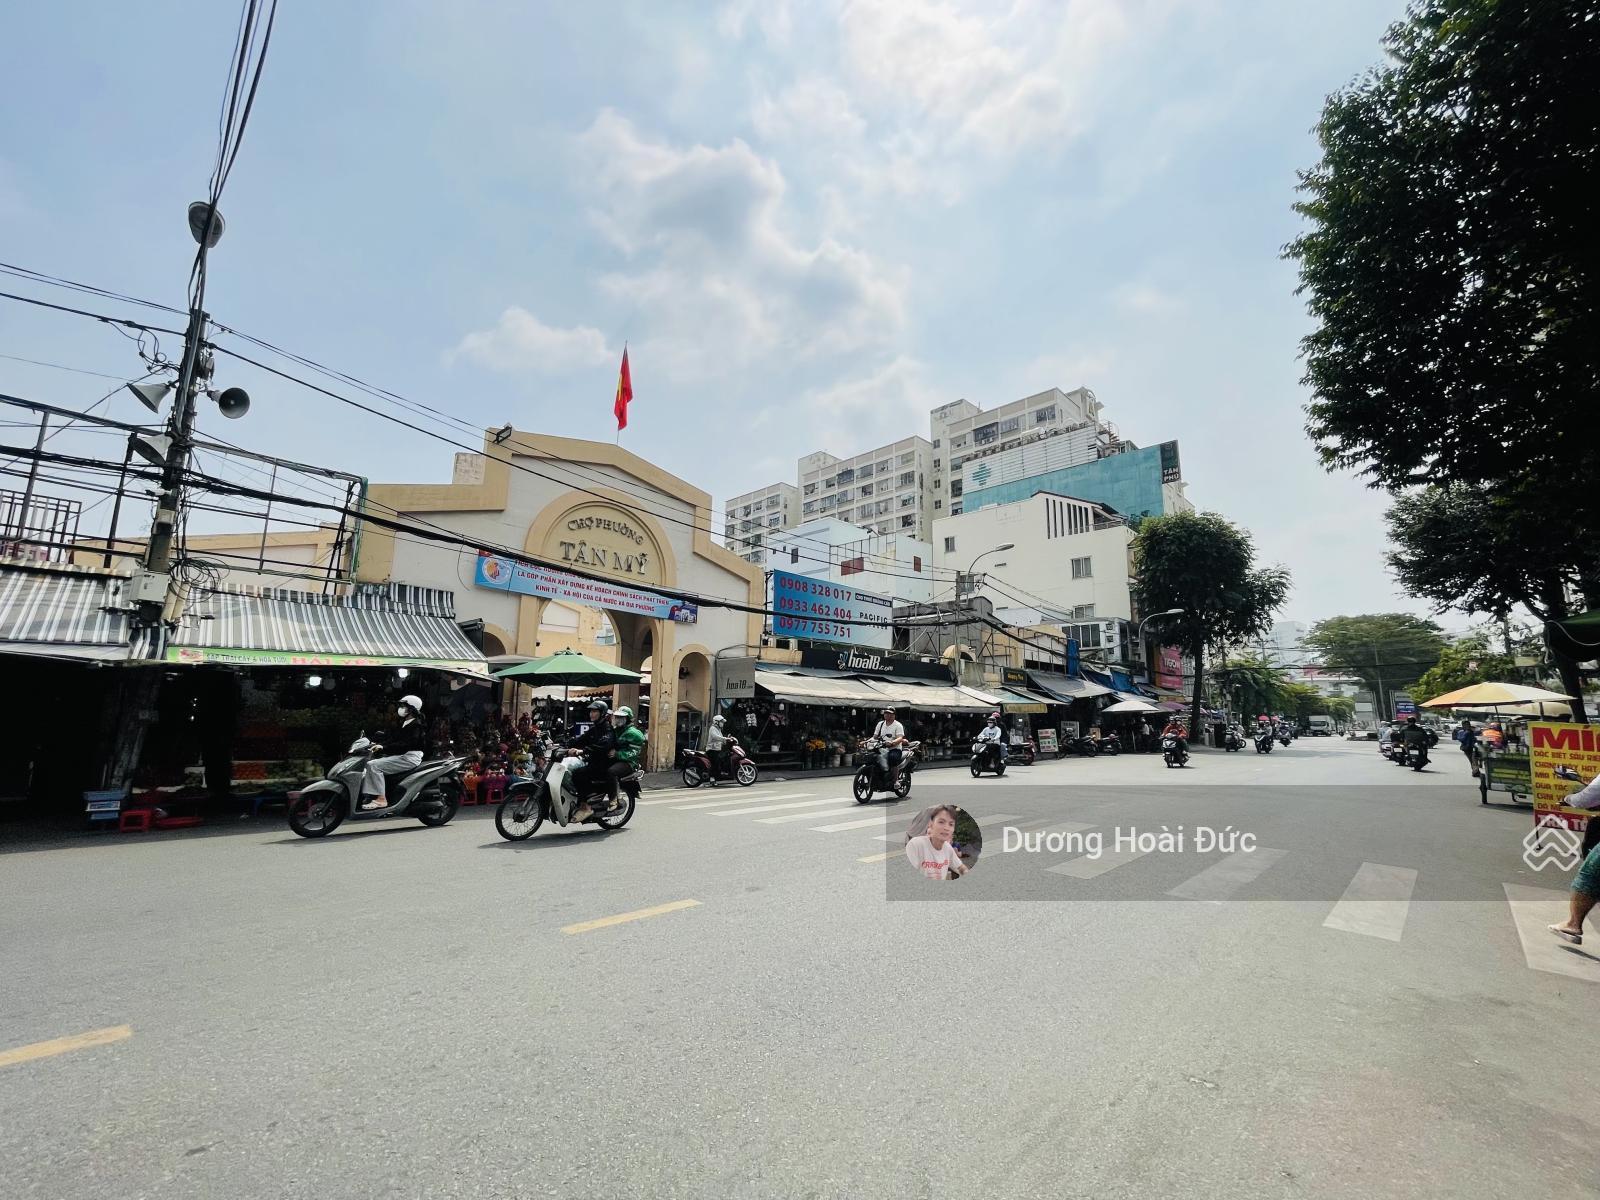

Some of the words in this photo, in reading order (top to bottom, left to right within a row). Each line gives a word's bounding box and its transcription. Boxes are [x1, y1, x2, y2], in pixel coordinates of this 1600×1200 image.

[567, 516, 594, 531] CHỢ
[595, 517, 644, 546] PHƯỜNG
[559, 539, 607, 567] TÂN
[612, 552, 649, 575] MỸ
[534, 583, 549, 592] KINH
[780, 576, 809, 593] 0908
[811, 583, 831, 597] 328
[833, 588, 852, 602] 017
[779, 597, 808, 613] 0933
[811, 603, 831, 616] 462
[833, 607, 852, 620] 404
[859, 612, 888, 624] PACIFIC
[779, 617, 808, 631] 0977
[811, 621, 830, 634] 755
[833, 625, 851, 638] 751
